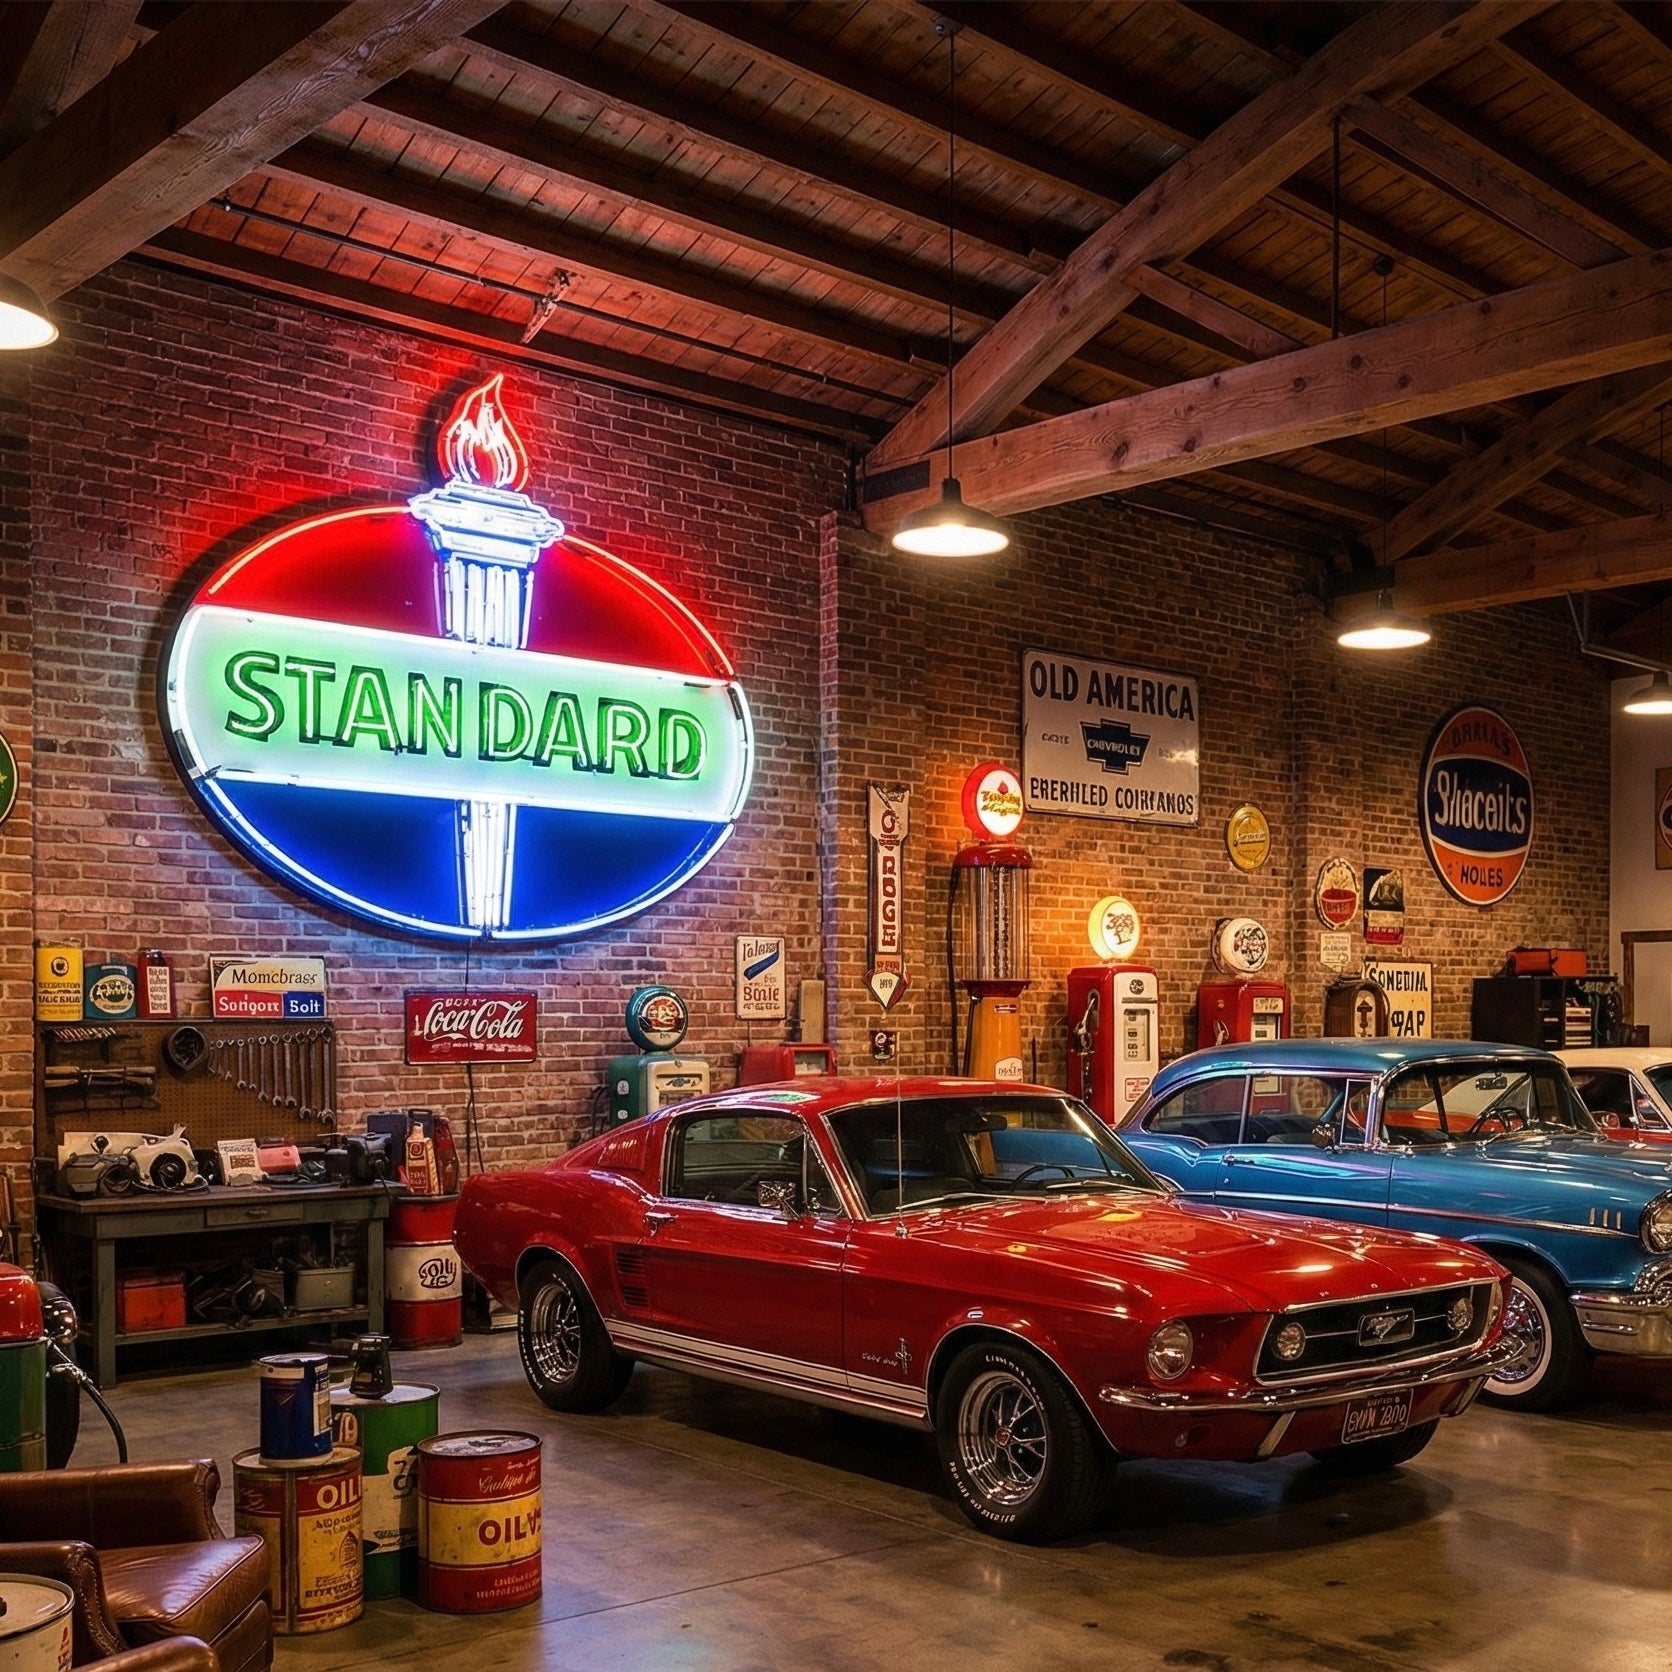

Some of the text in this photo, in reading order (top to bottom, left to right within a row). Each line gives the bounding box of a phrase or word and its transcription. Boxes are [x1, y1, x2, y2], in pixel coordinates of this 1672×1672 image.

[224, 650, 707, 781] STANDARD
[1029, 659, 1196, 722] OLD AMERICA
